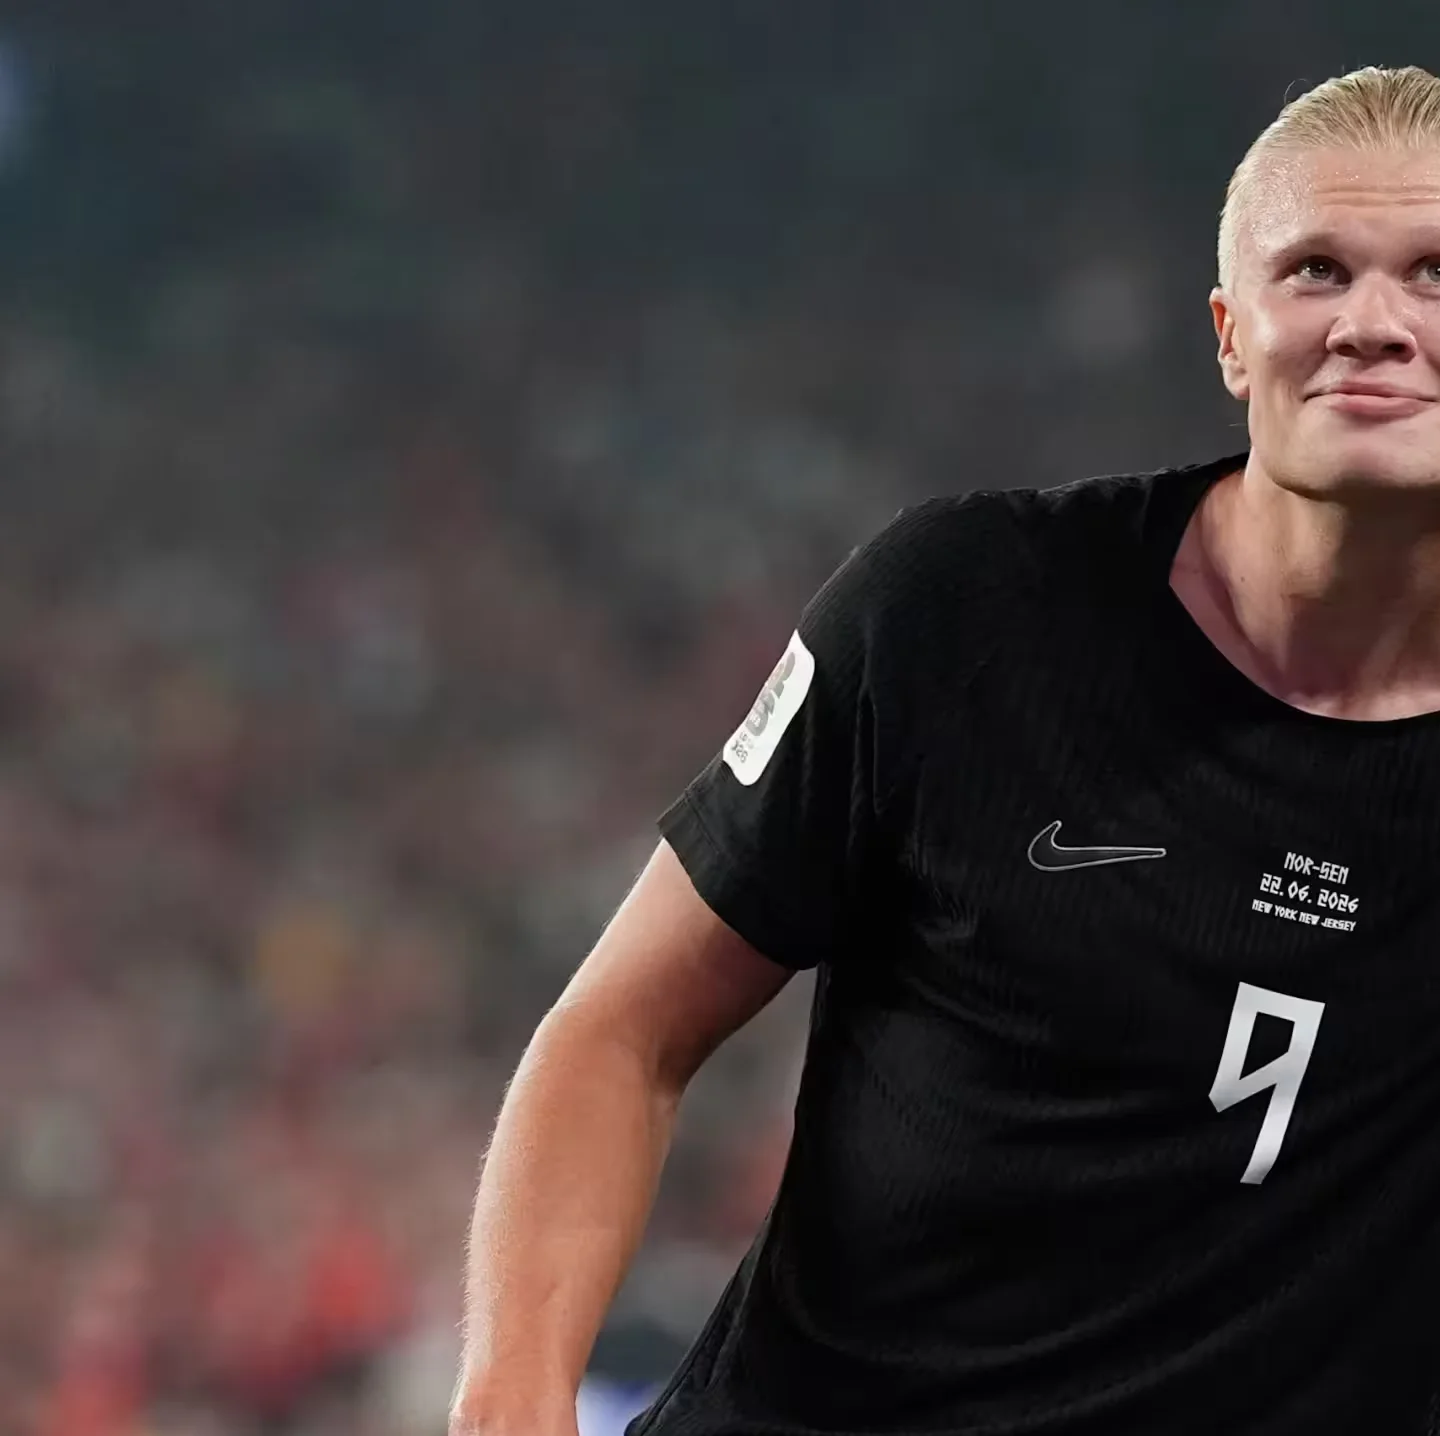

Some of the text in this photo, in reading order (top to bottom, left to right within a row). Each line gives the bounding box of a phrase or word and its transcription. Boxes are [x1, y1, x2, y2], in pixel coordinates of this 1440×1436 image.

[1283, 851, 1349, 885] NOR-SEN
[1251, 898, 1357, 932] NEW YORK NEW JERSEY
[1208, 981, 1326, 1185] 9
